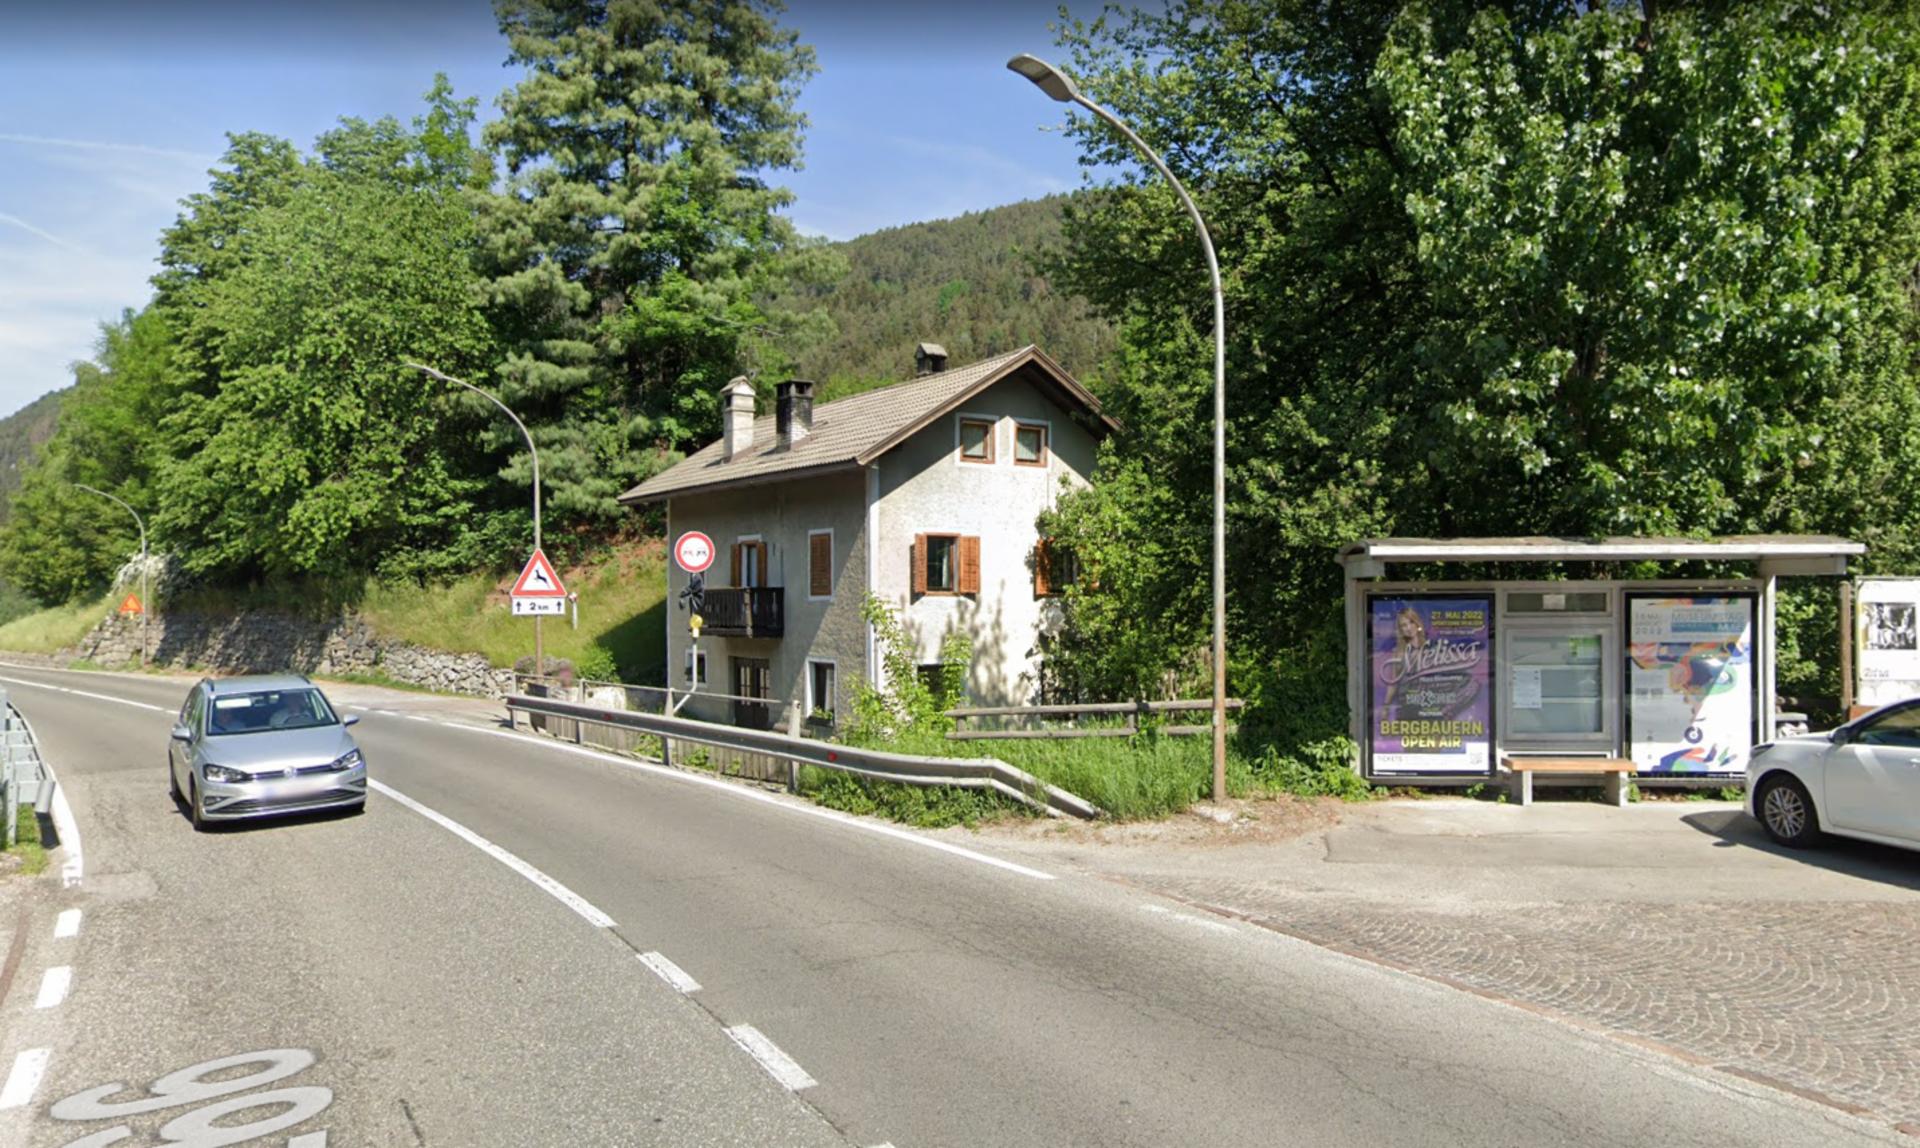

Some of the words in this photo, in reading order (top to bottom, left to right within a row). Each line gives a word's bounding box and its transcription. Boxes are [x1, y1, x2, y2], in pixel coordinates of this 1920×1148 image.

[530, 602, 536, 610] 2
[1462, 611, 1483, 619] 2022
[1381, 638, 1481, 684] Melissa
[1380, 720, 1483, 735] BERGBAUERN
[1401, 736, 1436, 748] OPEN
[1438, 736, 1462, 748] AIR
